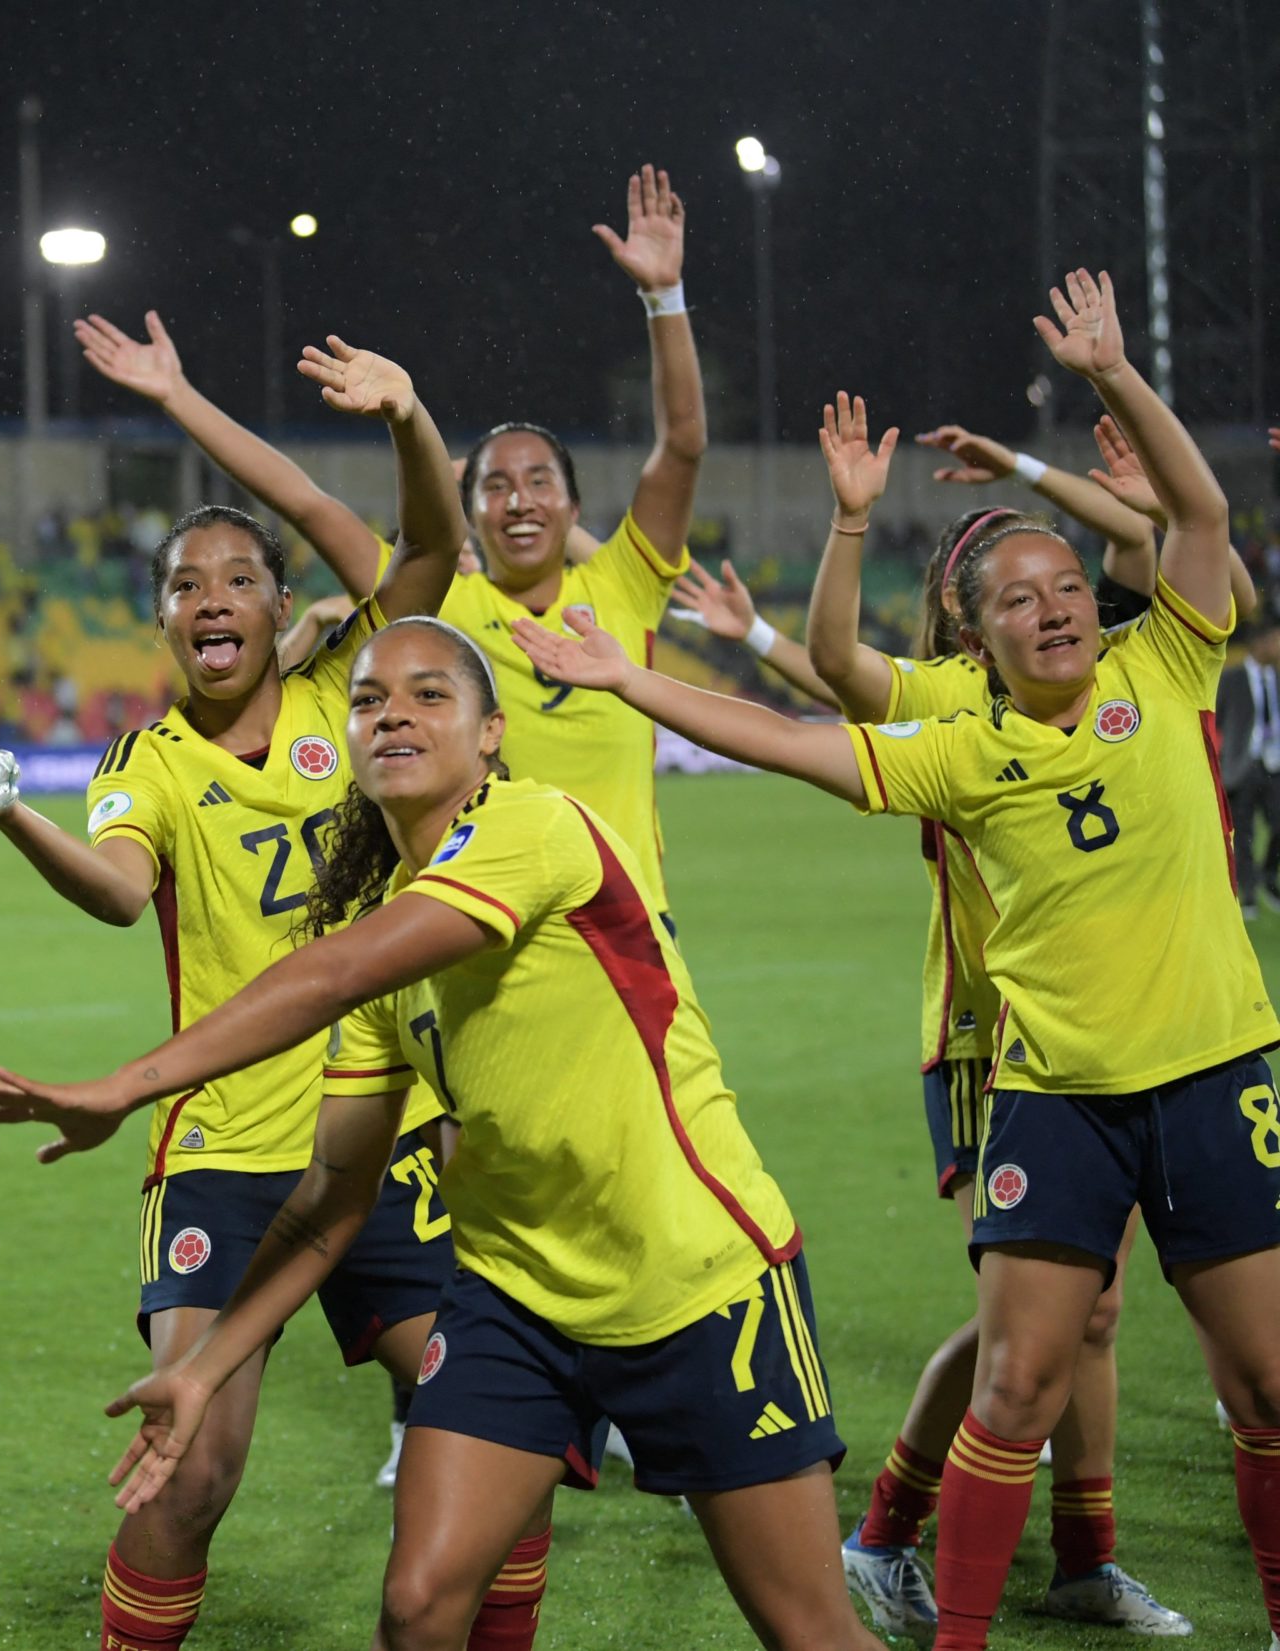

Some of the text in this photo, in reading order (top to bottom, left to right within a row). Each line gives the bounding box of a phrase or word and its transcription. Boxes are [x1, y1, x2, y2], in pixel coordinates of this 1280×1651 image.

[1057, 778, 1120, 853] 8
[409, 1009, 457, 1113] 7
[1239, 1083, 1280, 1169] 8
[715, 1279, 765, 1392] 7
